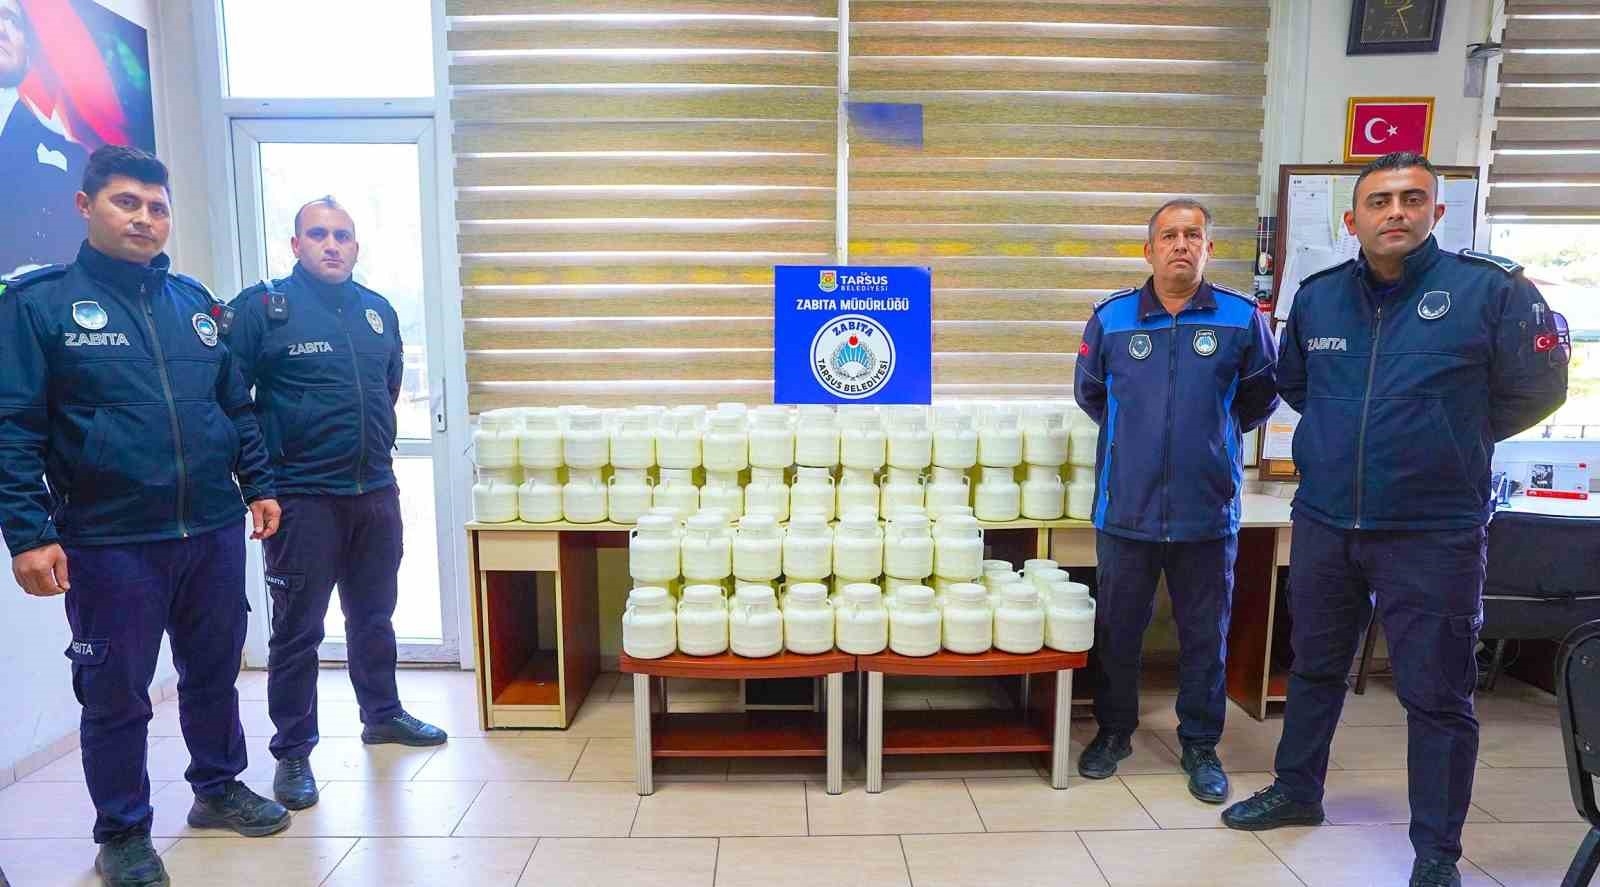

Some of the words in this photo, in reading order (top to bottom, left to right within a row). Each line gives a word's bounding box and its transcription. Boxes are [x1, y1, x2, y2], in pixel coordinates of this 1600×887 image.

[840, 275, 888, 285] TARSUS
[796, 299, 837, 311] ZABITA
[840, 297, 909, 311] MÜDÜRLÜĞÜ
[832, 321, 875, 337] ZABITA
[64, 332, 130, 347] ZABITA
[1307, 337, 1347, 351] ZABITA
[288, 341, 333, 356] ZABITA
[817, 357, 843, 390] TARSUS
[843, 360, 889, 393] BELEDİYESİ
